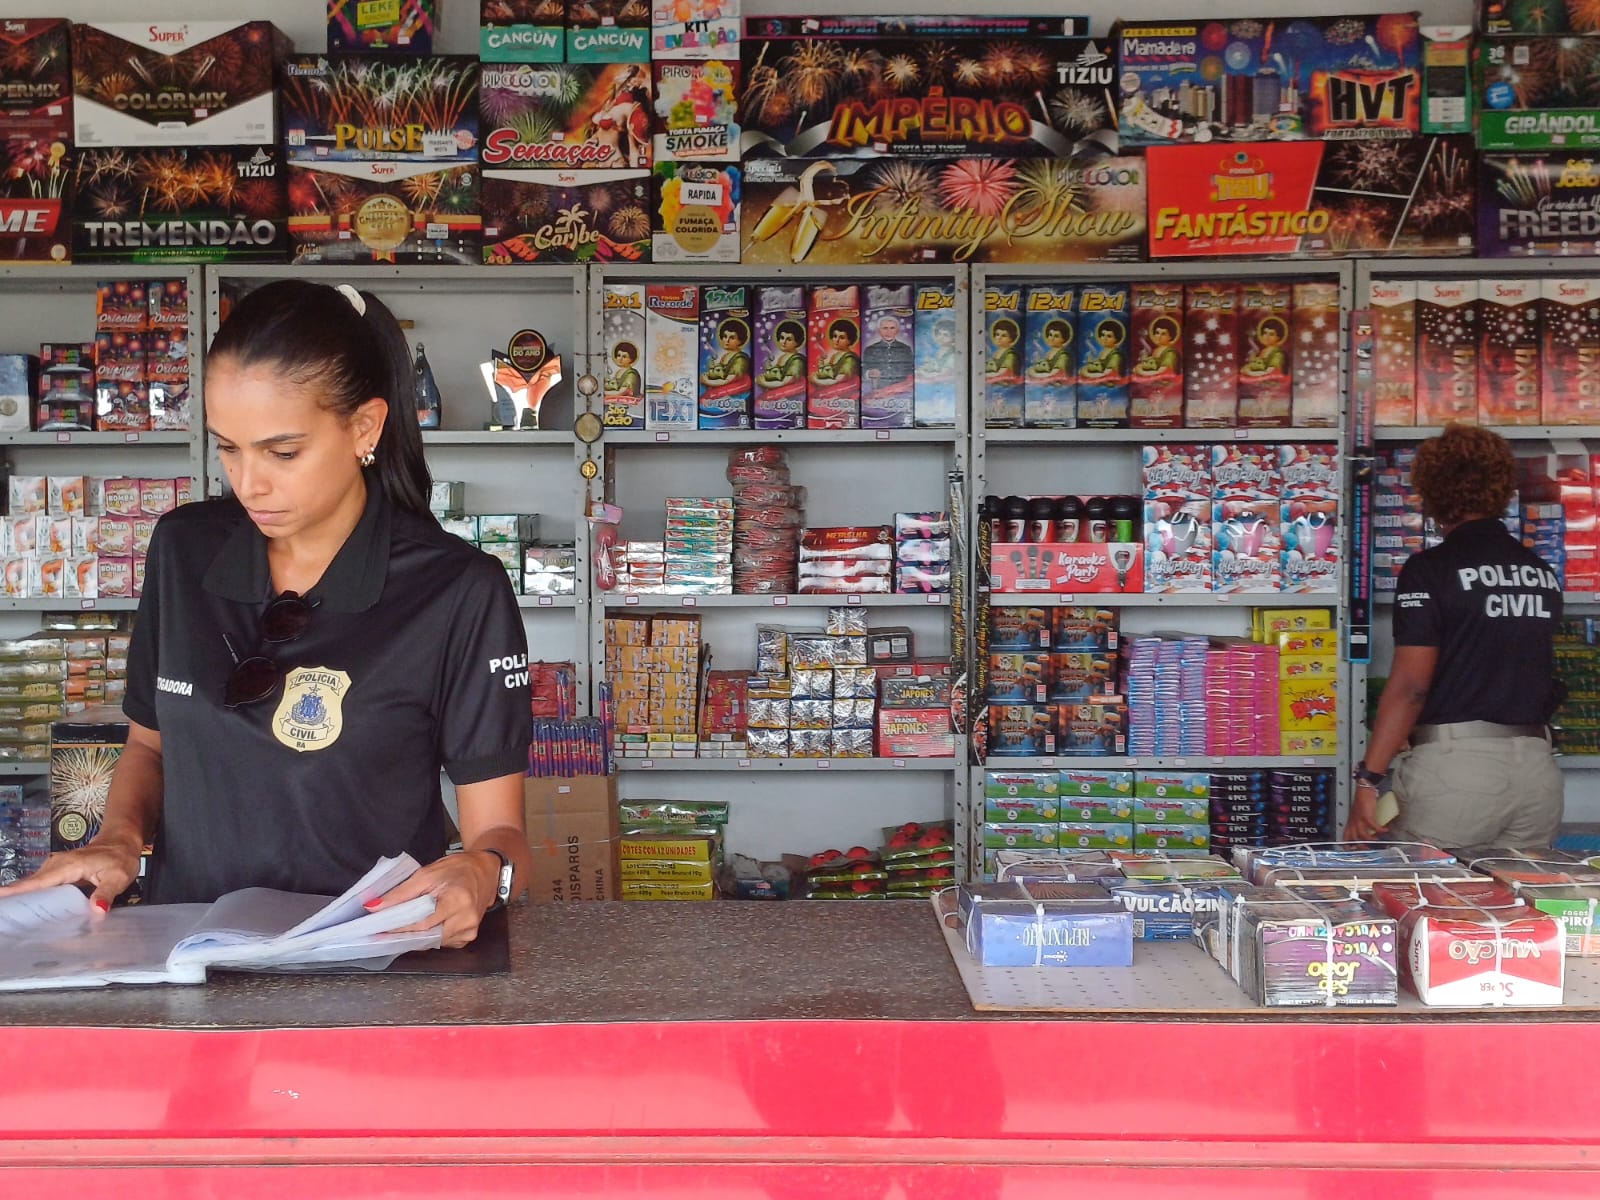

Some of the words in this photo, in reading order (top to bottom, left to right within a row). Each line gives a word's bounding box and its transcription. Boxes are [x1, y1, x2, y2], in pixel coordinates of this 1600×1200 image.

[684, 20, 710, 33] KIT
[488, 31, 558, 49] CANCÚN
[574, 31, 645, 50] CANCÚN
[1057, 67, 1113, 85] TIZIU
[113, 91, 228, 109] COLORMIX
[1328, 73, 1415, 121] HVT
[826, 86, 1033, 146] IMPÉRIO
[335, 122, 425, 152] PULSE
[482, 127, 616, 165] Sensação
[665, 134, 728, 150] SMOKE
[237, 161, 276, 178] TIZIU
[687, 189, 717, 201] RAPIDA
[84, 213, 277, 248] TREMENDÃO
[822, 184, 1001, 262] Infinity
[1000, 186, 1136, 247] Show
[1154, 204, 1330, 240] FANTÁSTICO
[534, 225, 602, 251] Caribe
[603, 292, 643, 309] 2x1
[1028, 292, 1073, 310] 12x1
[1080, 292, 1126, 311] 12x1
[1058, 551, 1107, 566] Karaoke
[1066, 564, 1099, 579] Party
[1485, 593, 1552, 619] CIVIL
[290, 727, 317, 740] CIVIL
[666, 846, 696, 856] UNIDADES
